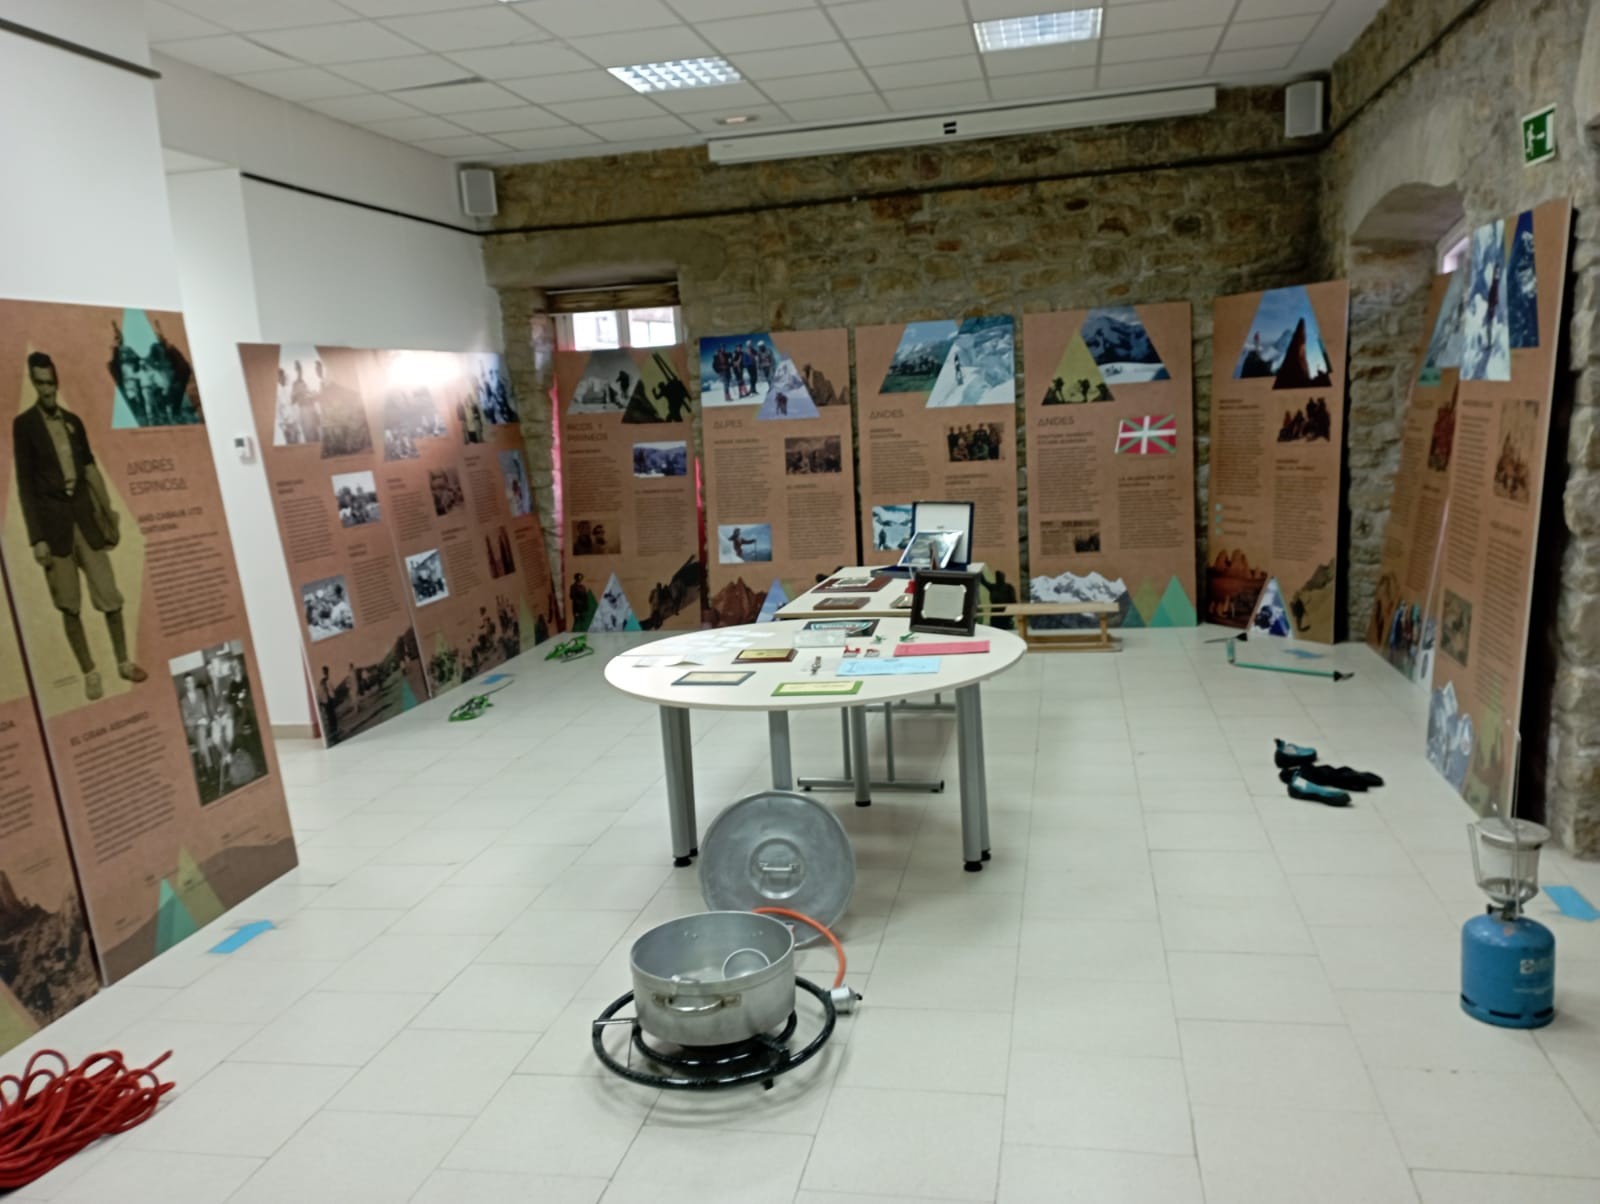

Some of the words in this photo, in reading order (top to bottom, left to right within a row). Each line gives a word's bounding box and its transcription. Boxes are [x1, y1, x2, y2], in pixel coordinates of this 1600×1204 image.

[868, 408, 904, 420] ANDES
[712, 419, 744, 430] ALPES
[1036, 416, 1075, 427] ANDES
[129, 477, 188, 496] ESPINOSA
